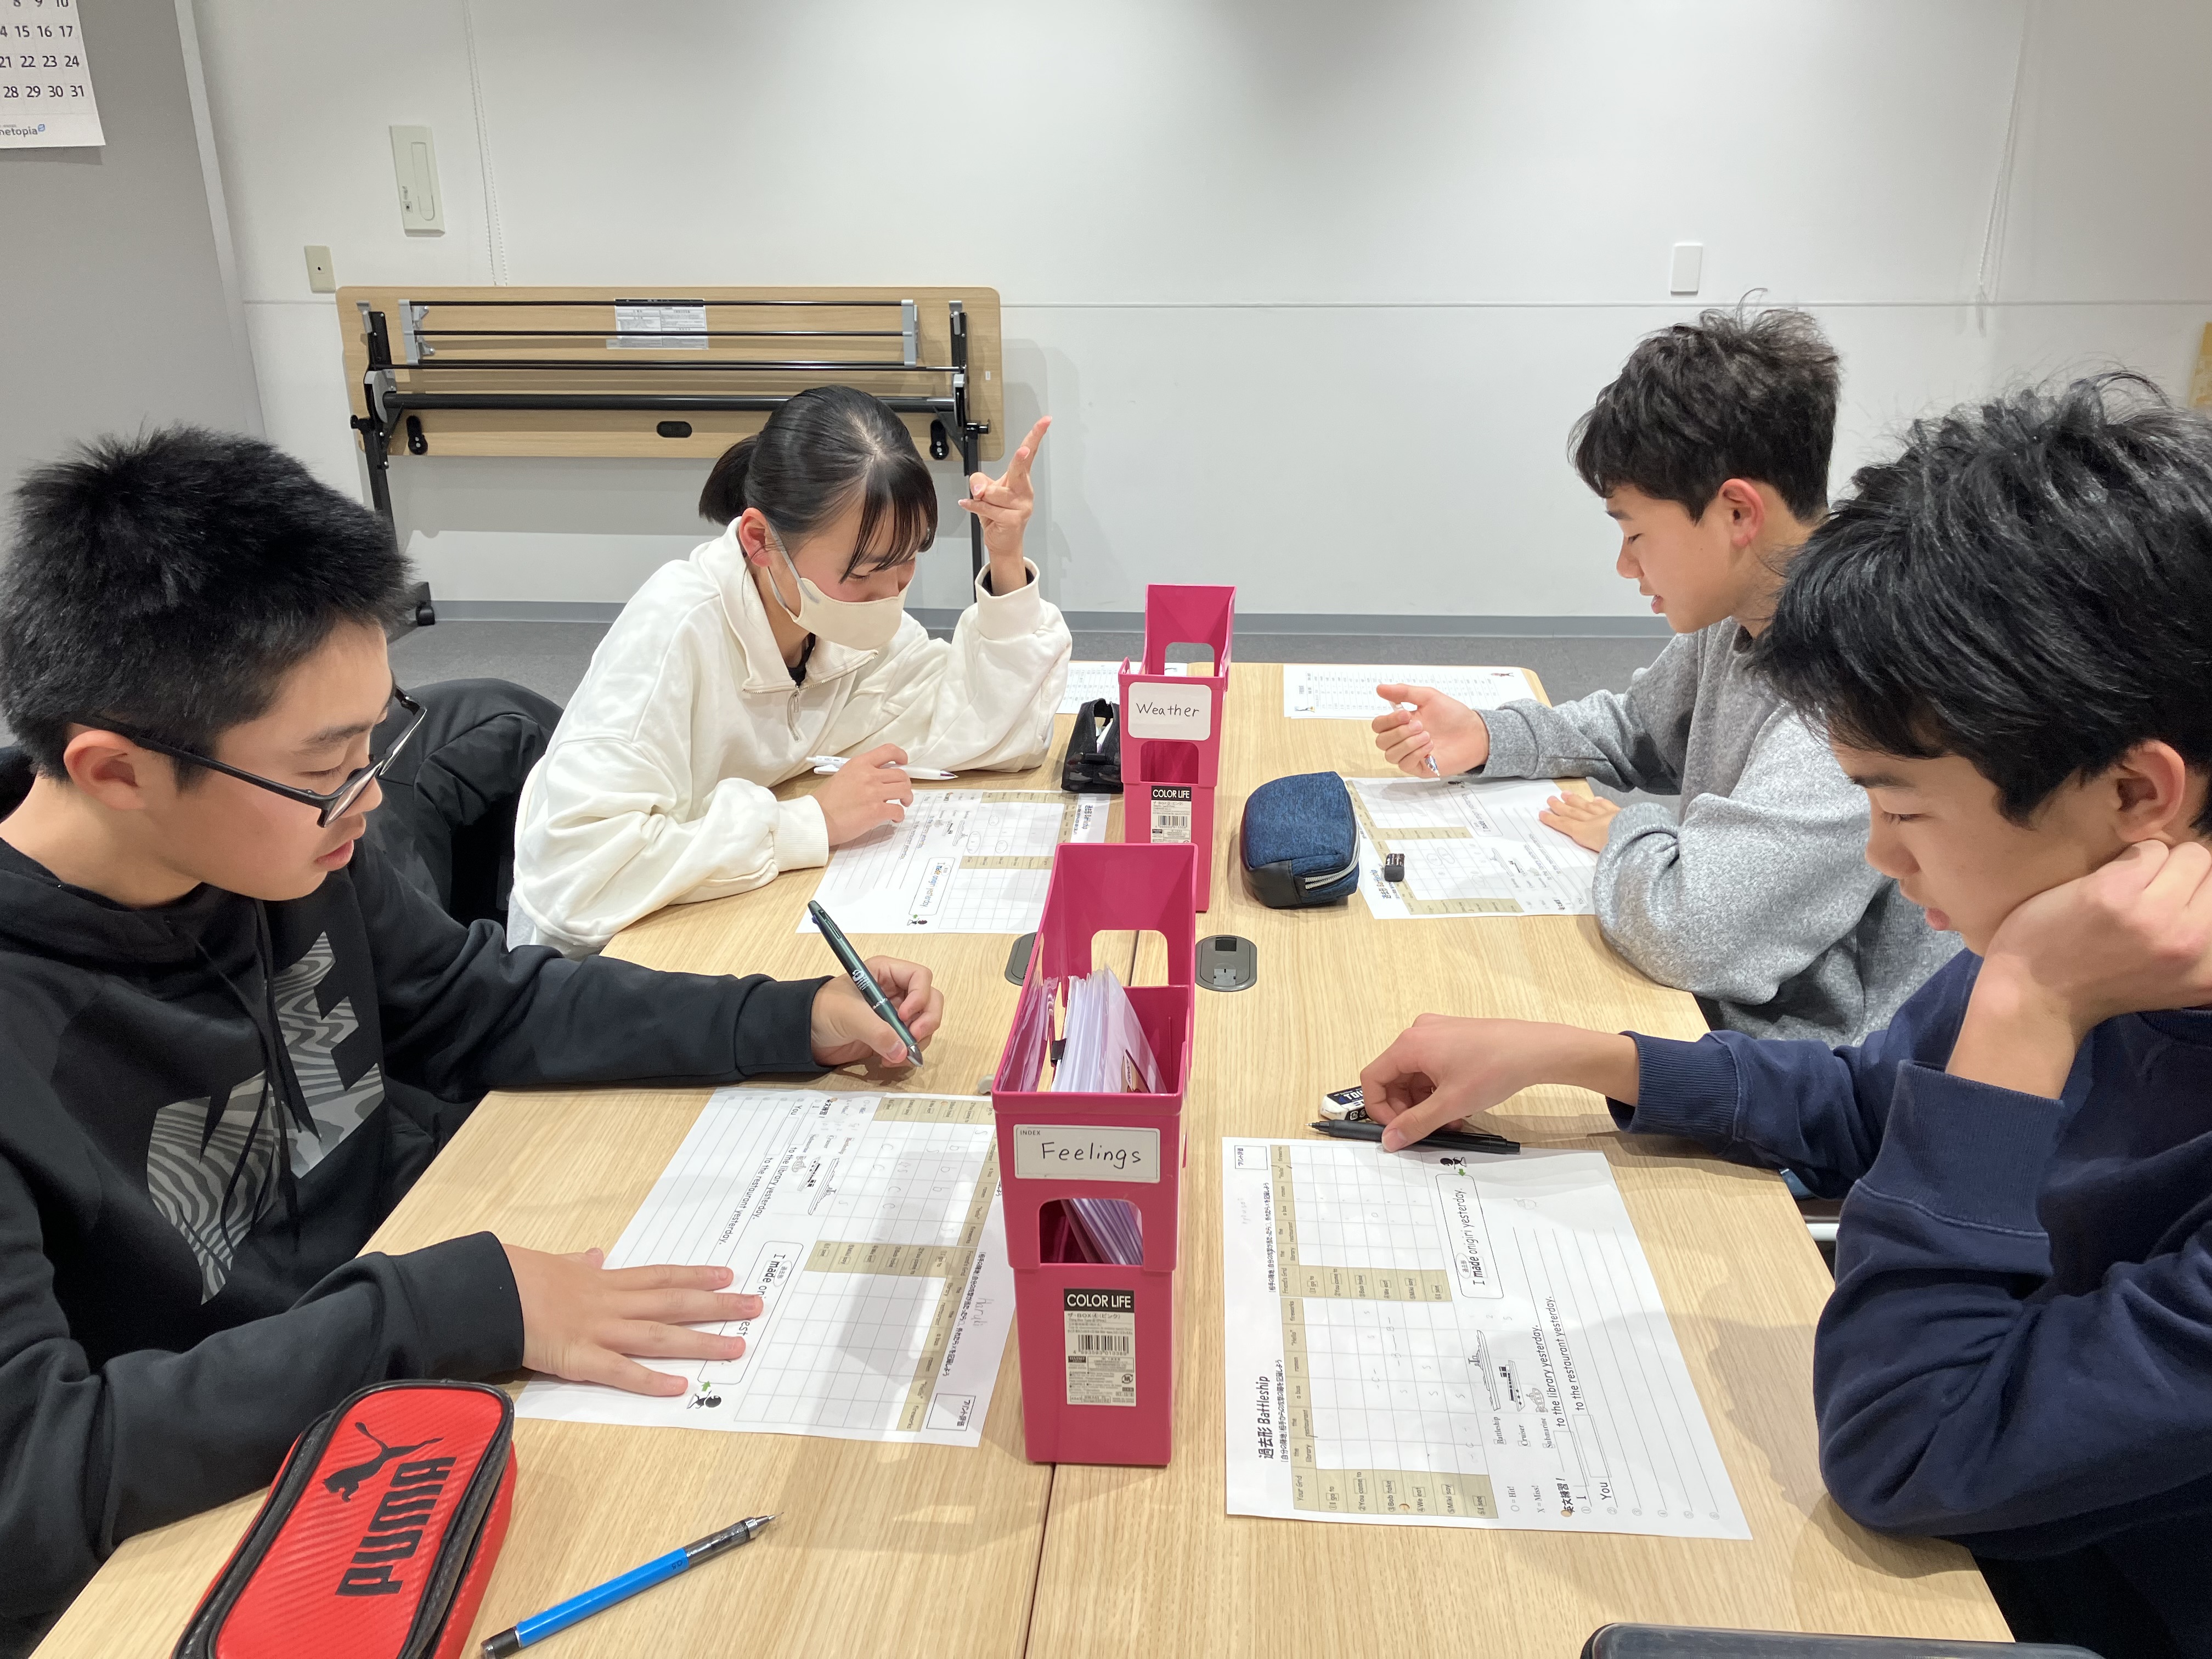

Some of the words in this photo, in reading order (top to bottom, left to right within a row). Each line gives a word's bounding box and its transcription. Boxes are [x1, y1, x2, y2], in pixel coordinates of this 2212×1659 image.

[0, 26, 8, 37] 4
[14, 26, 30, 37] 15
[37, 26, 52, 37] 16
[59, 26, 73, 37] 17
[0, 56, 12, 68] 21
[20, 56, 36, 67] 22
[42, 55, 57, 67] 23
[64, 55, 80, 67] 24
[3, 86, 19, 98] 28
[25, 86, 41, 97] 29
[47, 86, 63, 97] 30
[70, 85, 84, 97] 31
[1136, 702, 1200, 717] Weather
[1153, 789, 1177, 798] COLOR
[1178, 790, 1190, 798] LIFE
[923, 825, 932, 833] library
[906, 830, 916, 844] restaurant
[916, 834, 926, 849] yesterday.
[900, 845, 909, 860] yesterday.
[919, 888, 934, 908] yesterday.
[791, 1105, 802, 1115] You
[783, 1155, 793, 1164] the
[1041, 1142, 1141, 1169] Feelings
[758, 1165, 769, 1174] the
[769, 1166, 788, 1185] library
[740, 1176, 762, 1208] restaurant
[752, 1187, 775, 1220] yesterday.
[1453, 1189, 1474, 1228] yesterday.
[719, 1210, 743, 1244] yesterday.
[1462, 1230, 1479, 1254] onigiri
[763, 1261, 780, 1283] made
[1469, 1257, 1483, 1278] made
[1067, 1294, 1109, 1307] COLOR
[1111, 1295, 1131, 1308] LIFE
[1545, 1297, 1565, 1336] yesterday.
[1532, 1325, 1551, 1367] yesterday.
[1556, 1339, 1576, 1383] restaurant
[1543, 1369, 1558, 1397] library
[1256, 1376, 1271, 1424] Battleship
[1571, 1386, 1581, 1399] the
[1551, 1401, 1562, 1415] the
[1575, 1402, 1584, 1410] to
[907, 1406, 919, 1429] fireworks
[1556, 1418, 1566, 1427] to
[1492, 1417, 1504, 1443] Battleship
[1519, 1425, 1528, 1446] Cruiser
[1541, 1418, 1553, 1448] Submarine
[1257, 1427, 1273, 1459] 過去形
[1507, 1486, 1516, 1497] Hit!
[1532, 1486, 1542, 1501] Miss!
[1600, 1482, 1612, 1500] You
[335, 1457, 456, 1596] PUMA
[671, 1560, 683, 1571] 0.5
